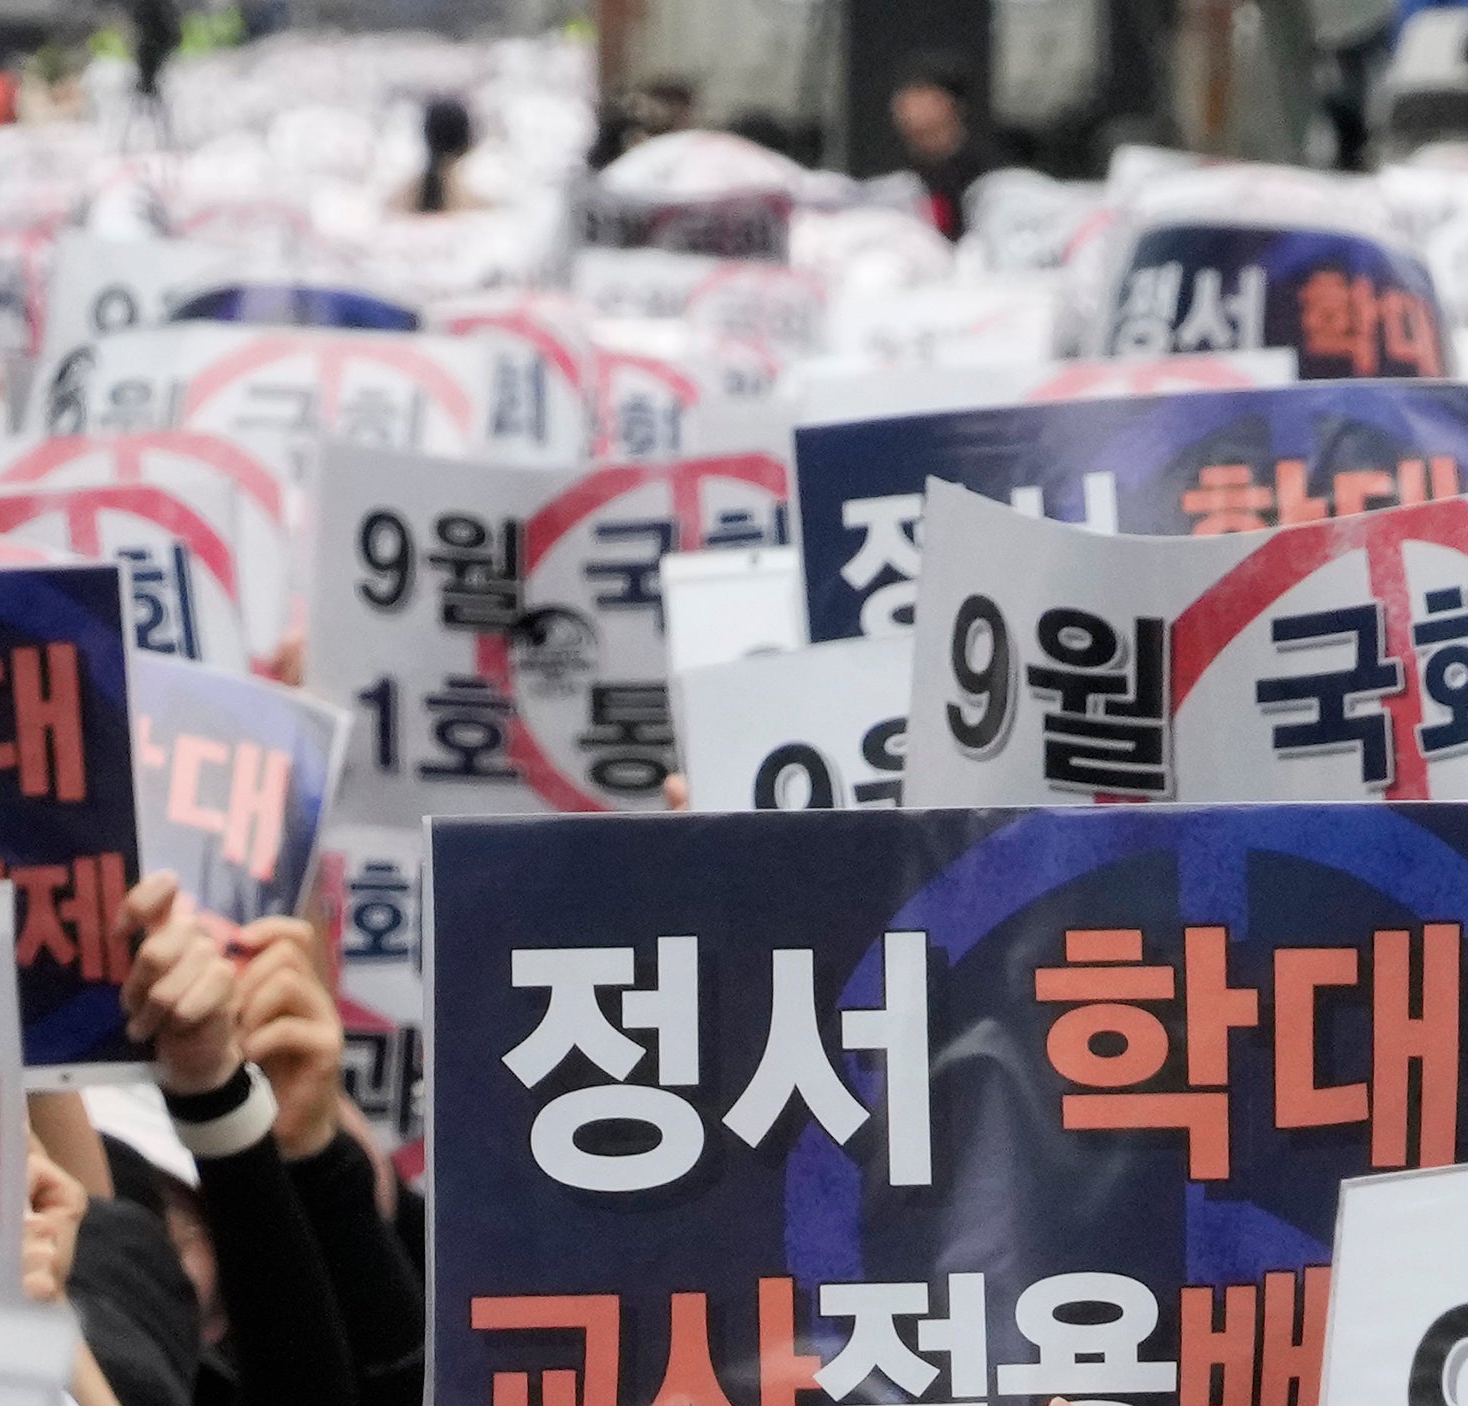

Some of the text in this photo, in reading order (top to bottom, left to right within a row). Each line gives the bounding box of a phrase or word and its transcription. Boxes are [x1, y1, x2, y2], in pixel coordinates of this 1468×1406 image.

[357, 508, 526, 630] 9월
[357, 675, 523, 782] 1호
[945, 592, 1176, 797] 9월
[137, 712, 293, 882] 대
[501, 922, 1461, 1192] 정서 학대
